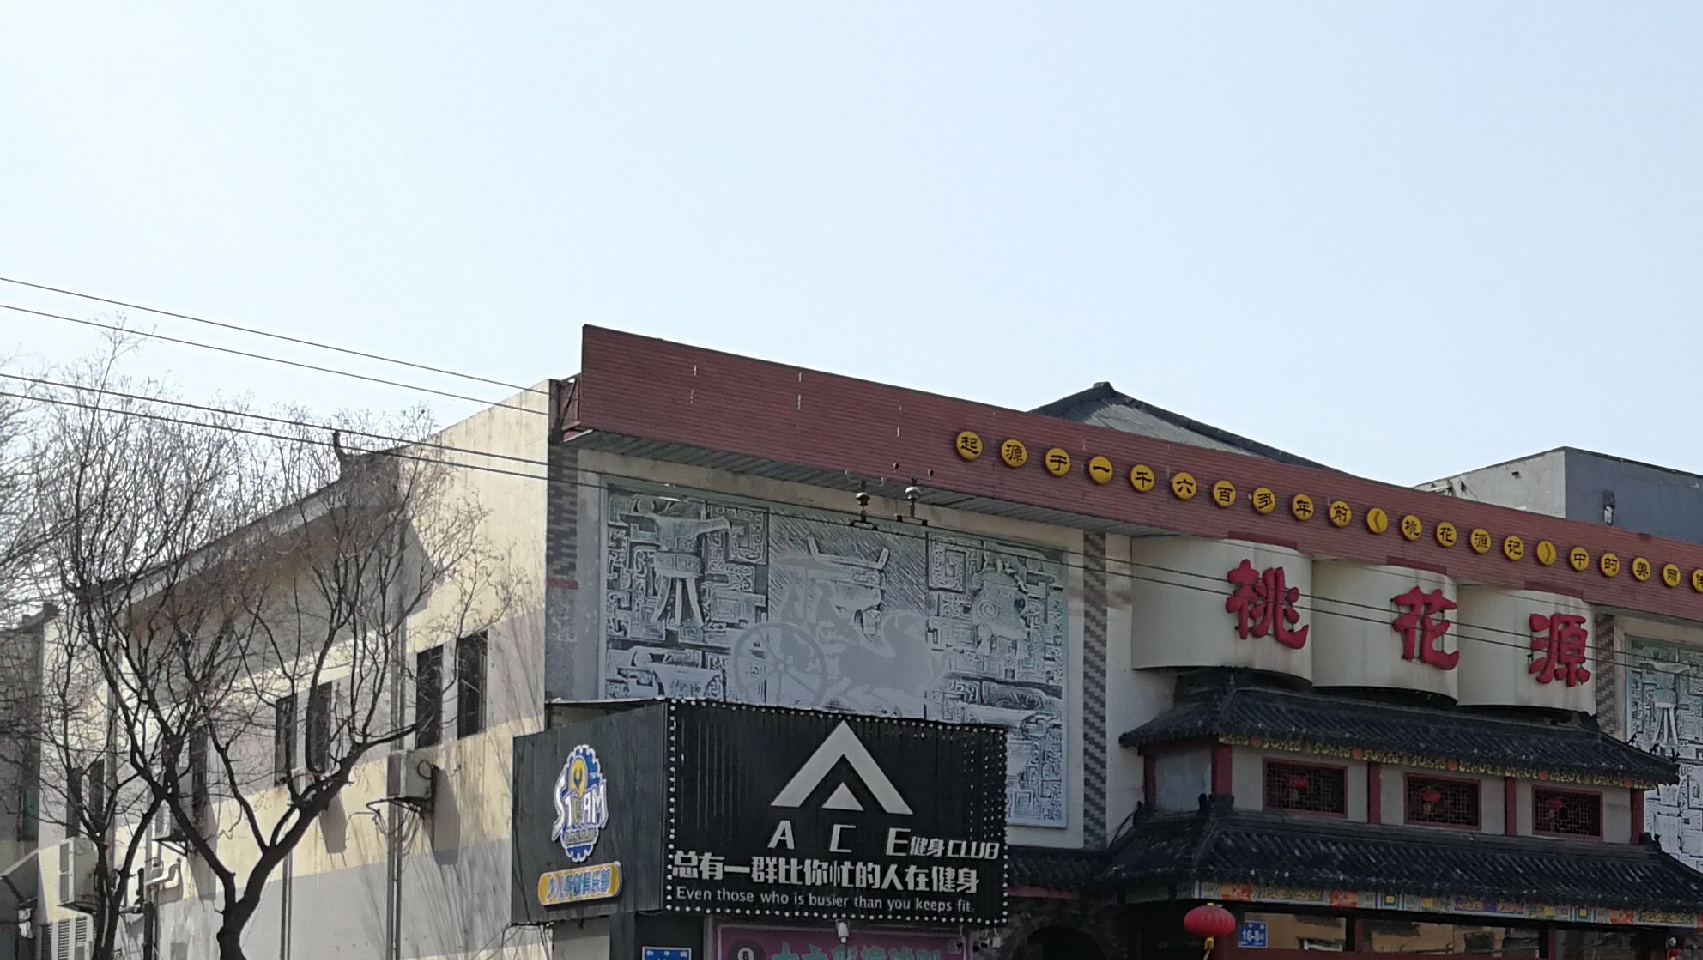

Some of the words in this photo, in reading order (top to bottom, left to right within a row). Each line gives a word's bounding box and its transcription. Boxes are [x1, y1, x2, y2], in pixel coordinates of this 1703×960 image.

[1226, 559, 1591, 688] 桃花源
[672, 849, 980, 895] 总有一群比你忙的人在健身
[676, 886, 712, 901] Even
[717, 889, 754, 903] those
[760, 891, 788, 905] who
[794, 892, 804, 905] is
[808, 894, 849, 908] busier
[854, 896, 882, 909] than
[887, 899, 911, 912] you
[915, 898, 952, 914] keeps
